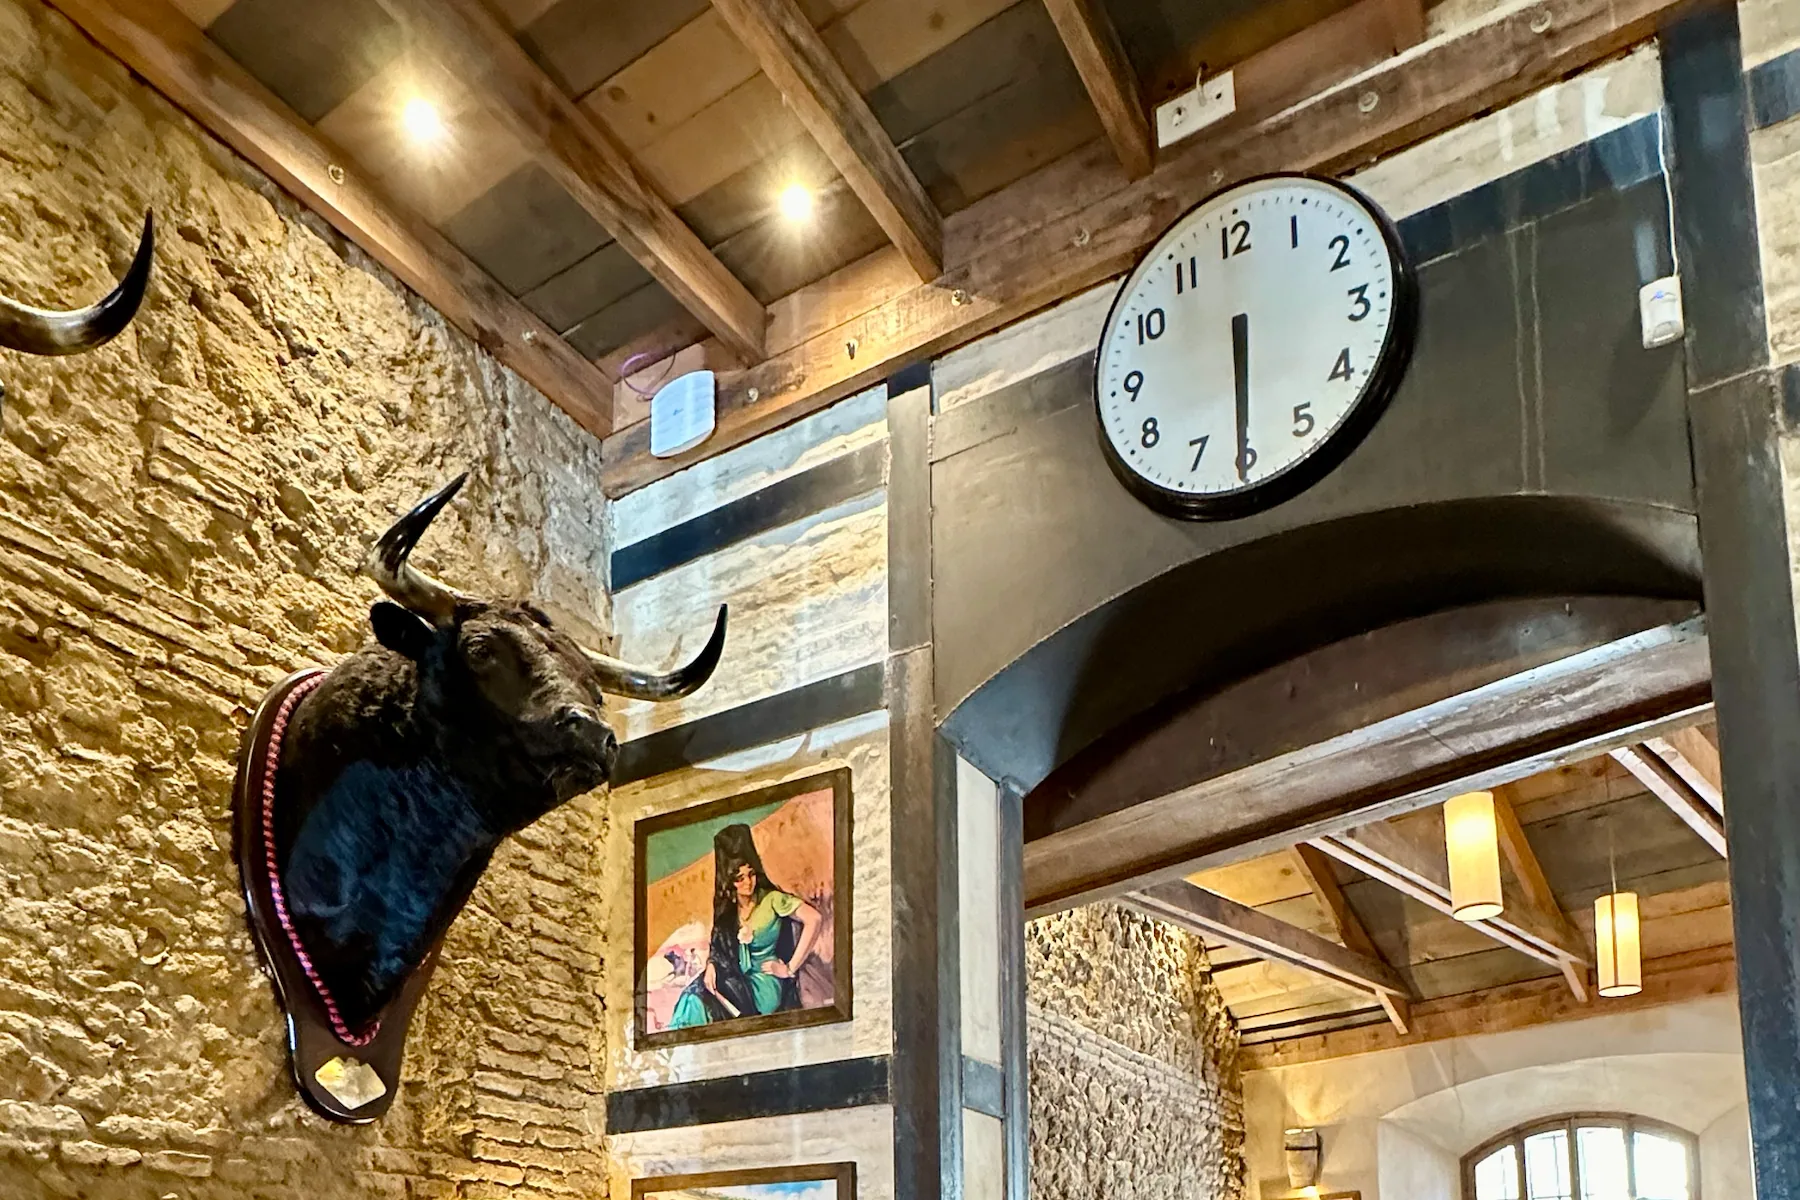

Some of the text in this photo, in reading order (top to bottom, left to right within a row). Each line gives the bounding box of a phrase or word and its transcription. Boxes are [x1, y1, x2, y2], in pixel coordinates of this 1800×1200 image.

[1221, 220, 1251, 260] 12
[1291, 215, 1297, 248] 1
[1329, 235, 1350, 272] 2
[1176, 256, 1197, 294] 11
[1348, 283, 1370, 322] 3
[1138, 308, 1165, 345] 10
[1328, 348, 1354, 381] 4
[1124, 371, 1143, 402] 9
[1142, 417, 1159, 448] 8
[1292, 402, 1314, 437] 5
[1189, 435, 1209, 472] 7
[1235, 438, 1257, 470] 6
